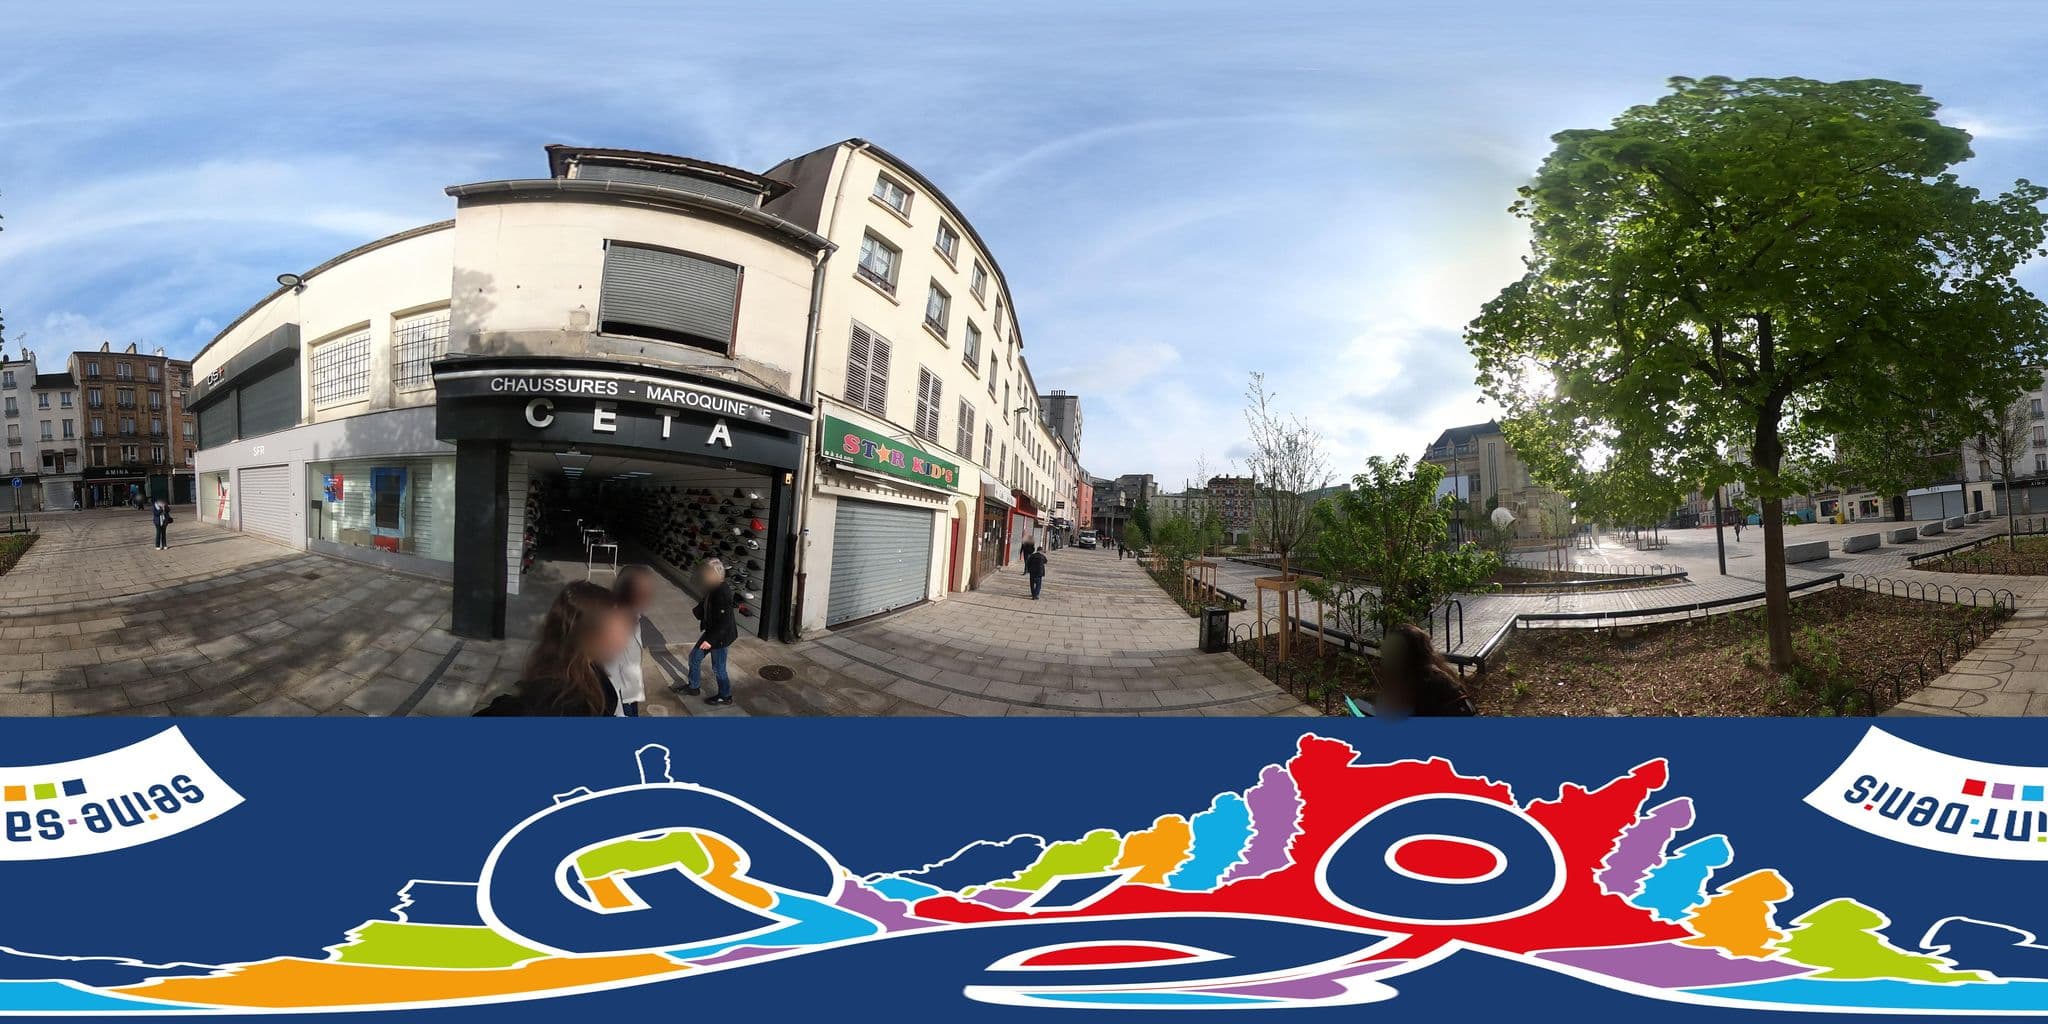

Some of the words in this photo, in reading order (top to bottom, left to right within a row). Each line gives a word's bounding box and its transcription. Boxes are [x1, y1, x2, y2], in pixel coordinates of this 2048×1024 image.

[491, 377, 618, 395] CHAUSSURES
[646, 385, 771, 422] MAROQUINEE
[525, 398, 733, 448] CETA
[253, 445, 265, 457] SFR
[912, 456, 953, 483] KID'S
